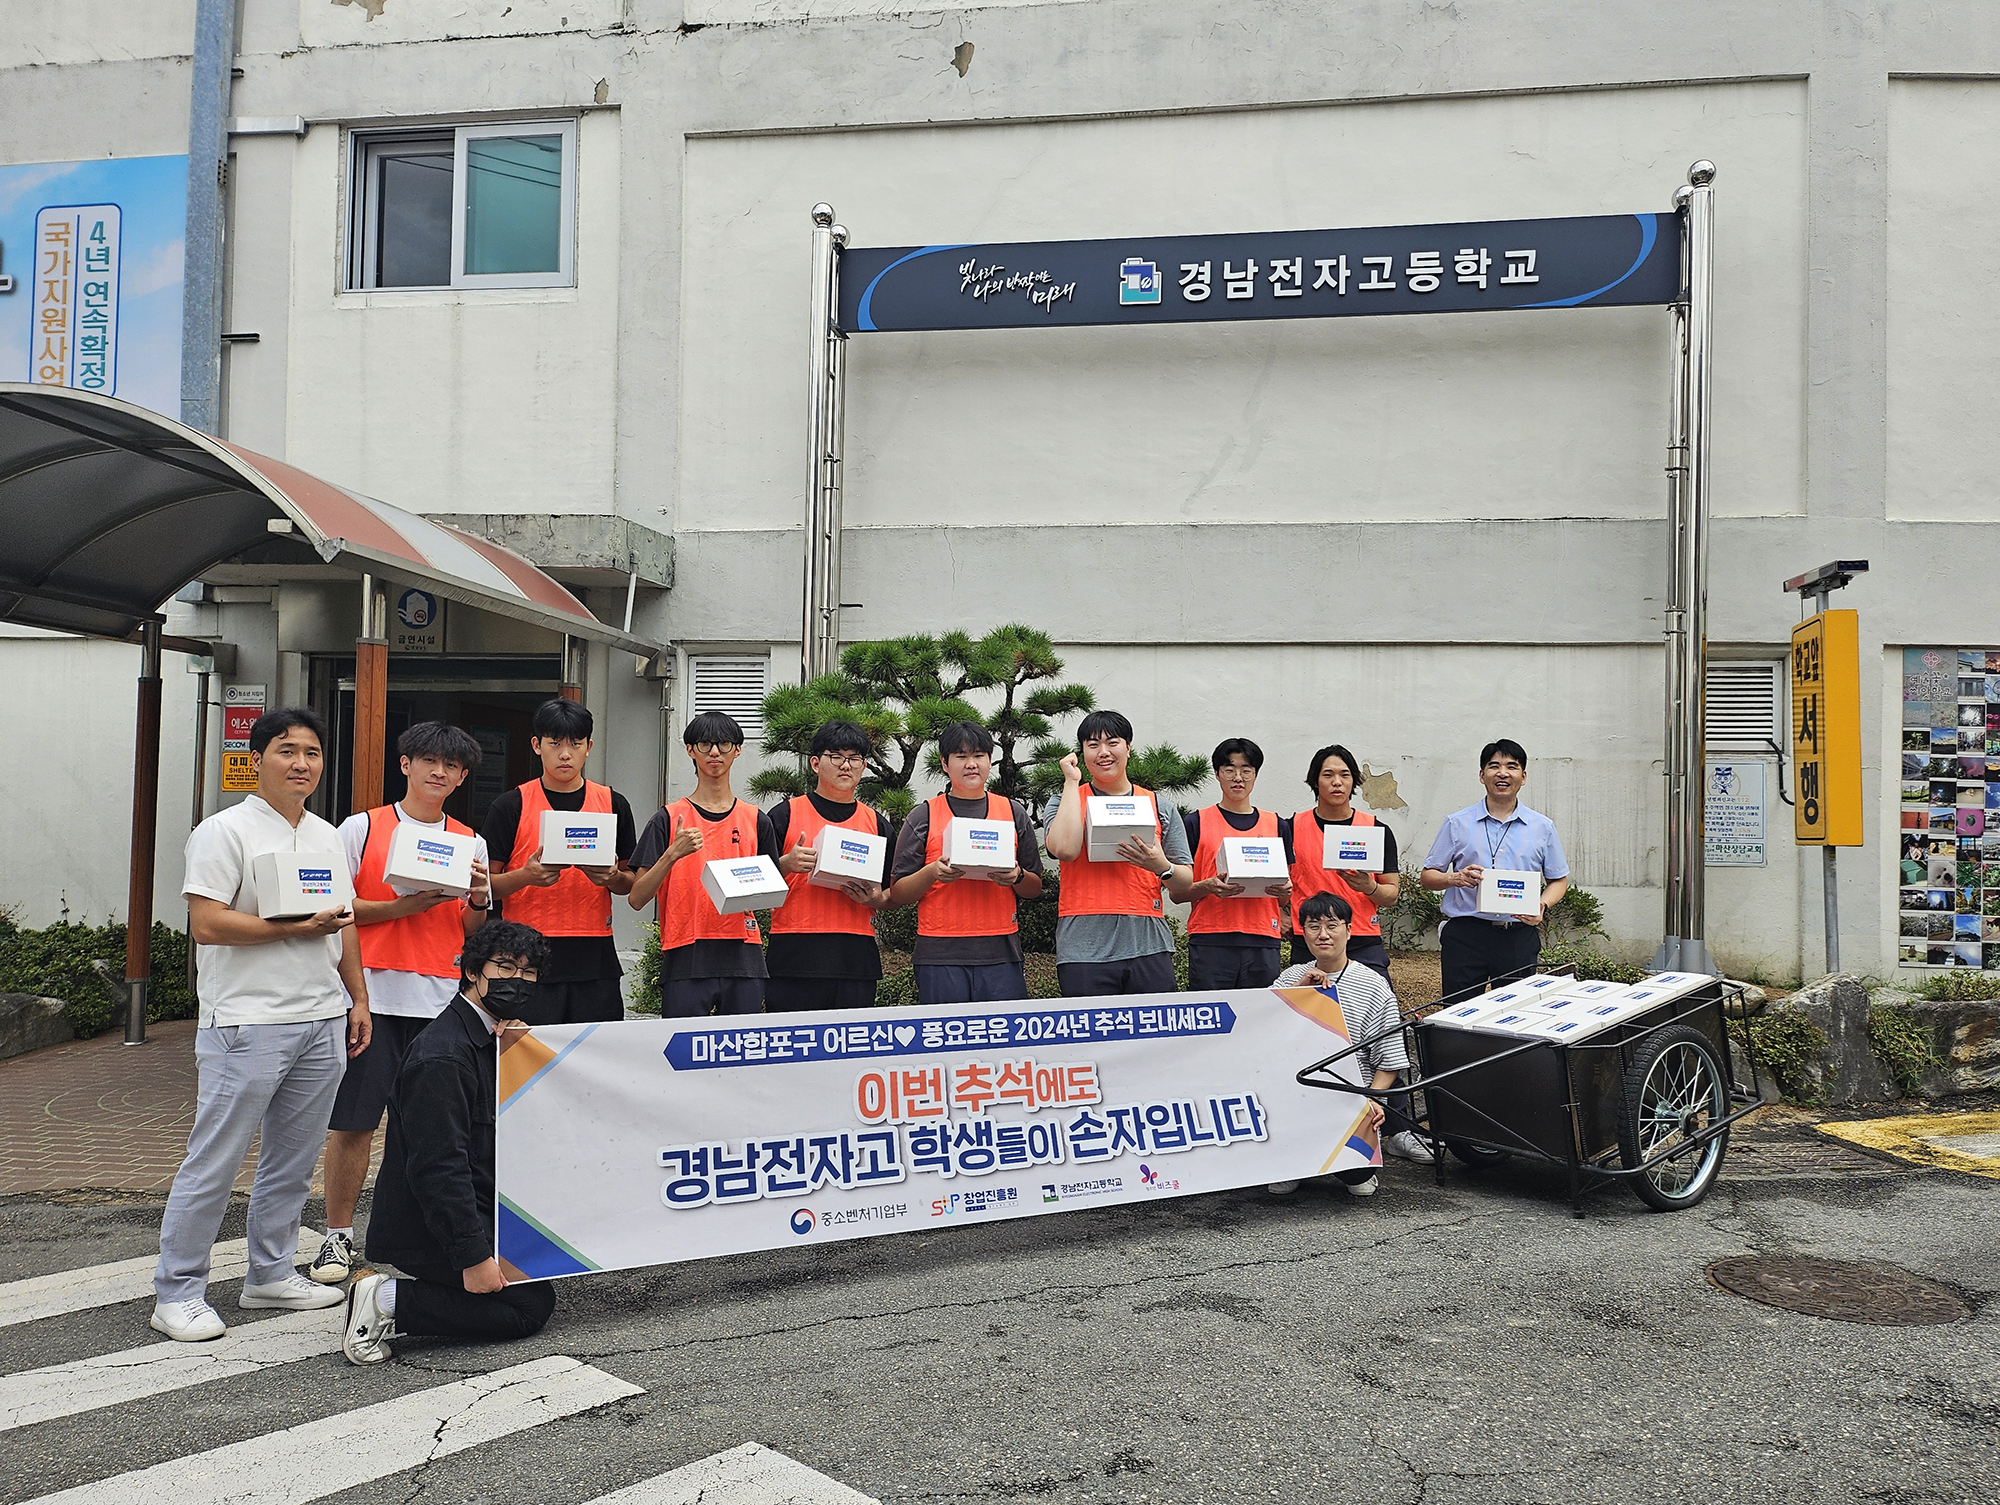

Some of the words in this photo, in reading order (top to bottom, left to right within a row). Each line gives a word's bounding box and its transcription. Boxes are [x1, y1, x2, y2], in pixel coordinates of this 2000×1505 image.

[84, 220, 110, 273] 4년
[973, 279, 1004, 303] 나의
[1177, 247, 1541, 302] 경남전자고등학교
[1032, 281, 1076, 313] 미래
[80, 281, 110, 389] 연속확정
[398, 634, 435, 645] 금연시설
[1795, 636, 1820, 686] 학교앞
[229, 757, 253, 767] 대피
[1798, 692, 1819, 826] 서행
[1715, 844, 1762, 854] 마산상남교회
[691, 1028, 818, 1063] 마산합포구
[823, 1023, 894, 1054] 어르신
[921, 1017, 1010, 1048] 풍요로운
[1013, 1011, 1091, 1041] 2024년
[1094, 1010, 1135, 1036] 추석
[1138, 1006, 1222, 1033] 보내세요!
[857, 1066, 945, 1121] 이번
[953, 1060, 1099, 1113] 추석에도
[662, 1130, 901, 1204] 경남전자고
[908, 1119, 1061, 1174] 학생들이
[1068, 1094, 1264, 1160] 손자입니다
[963, 1187, 1018, 1205] 창업진흥원
[1060, 1177, 1123, 1194] 경남전자고등학교
[821, 1203, 908, 1227] 중소벤처기업부
